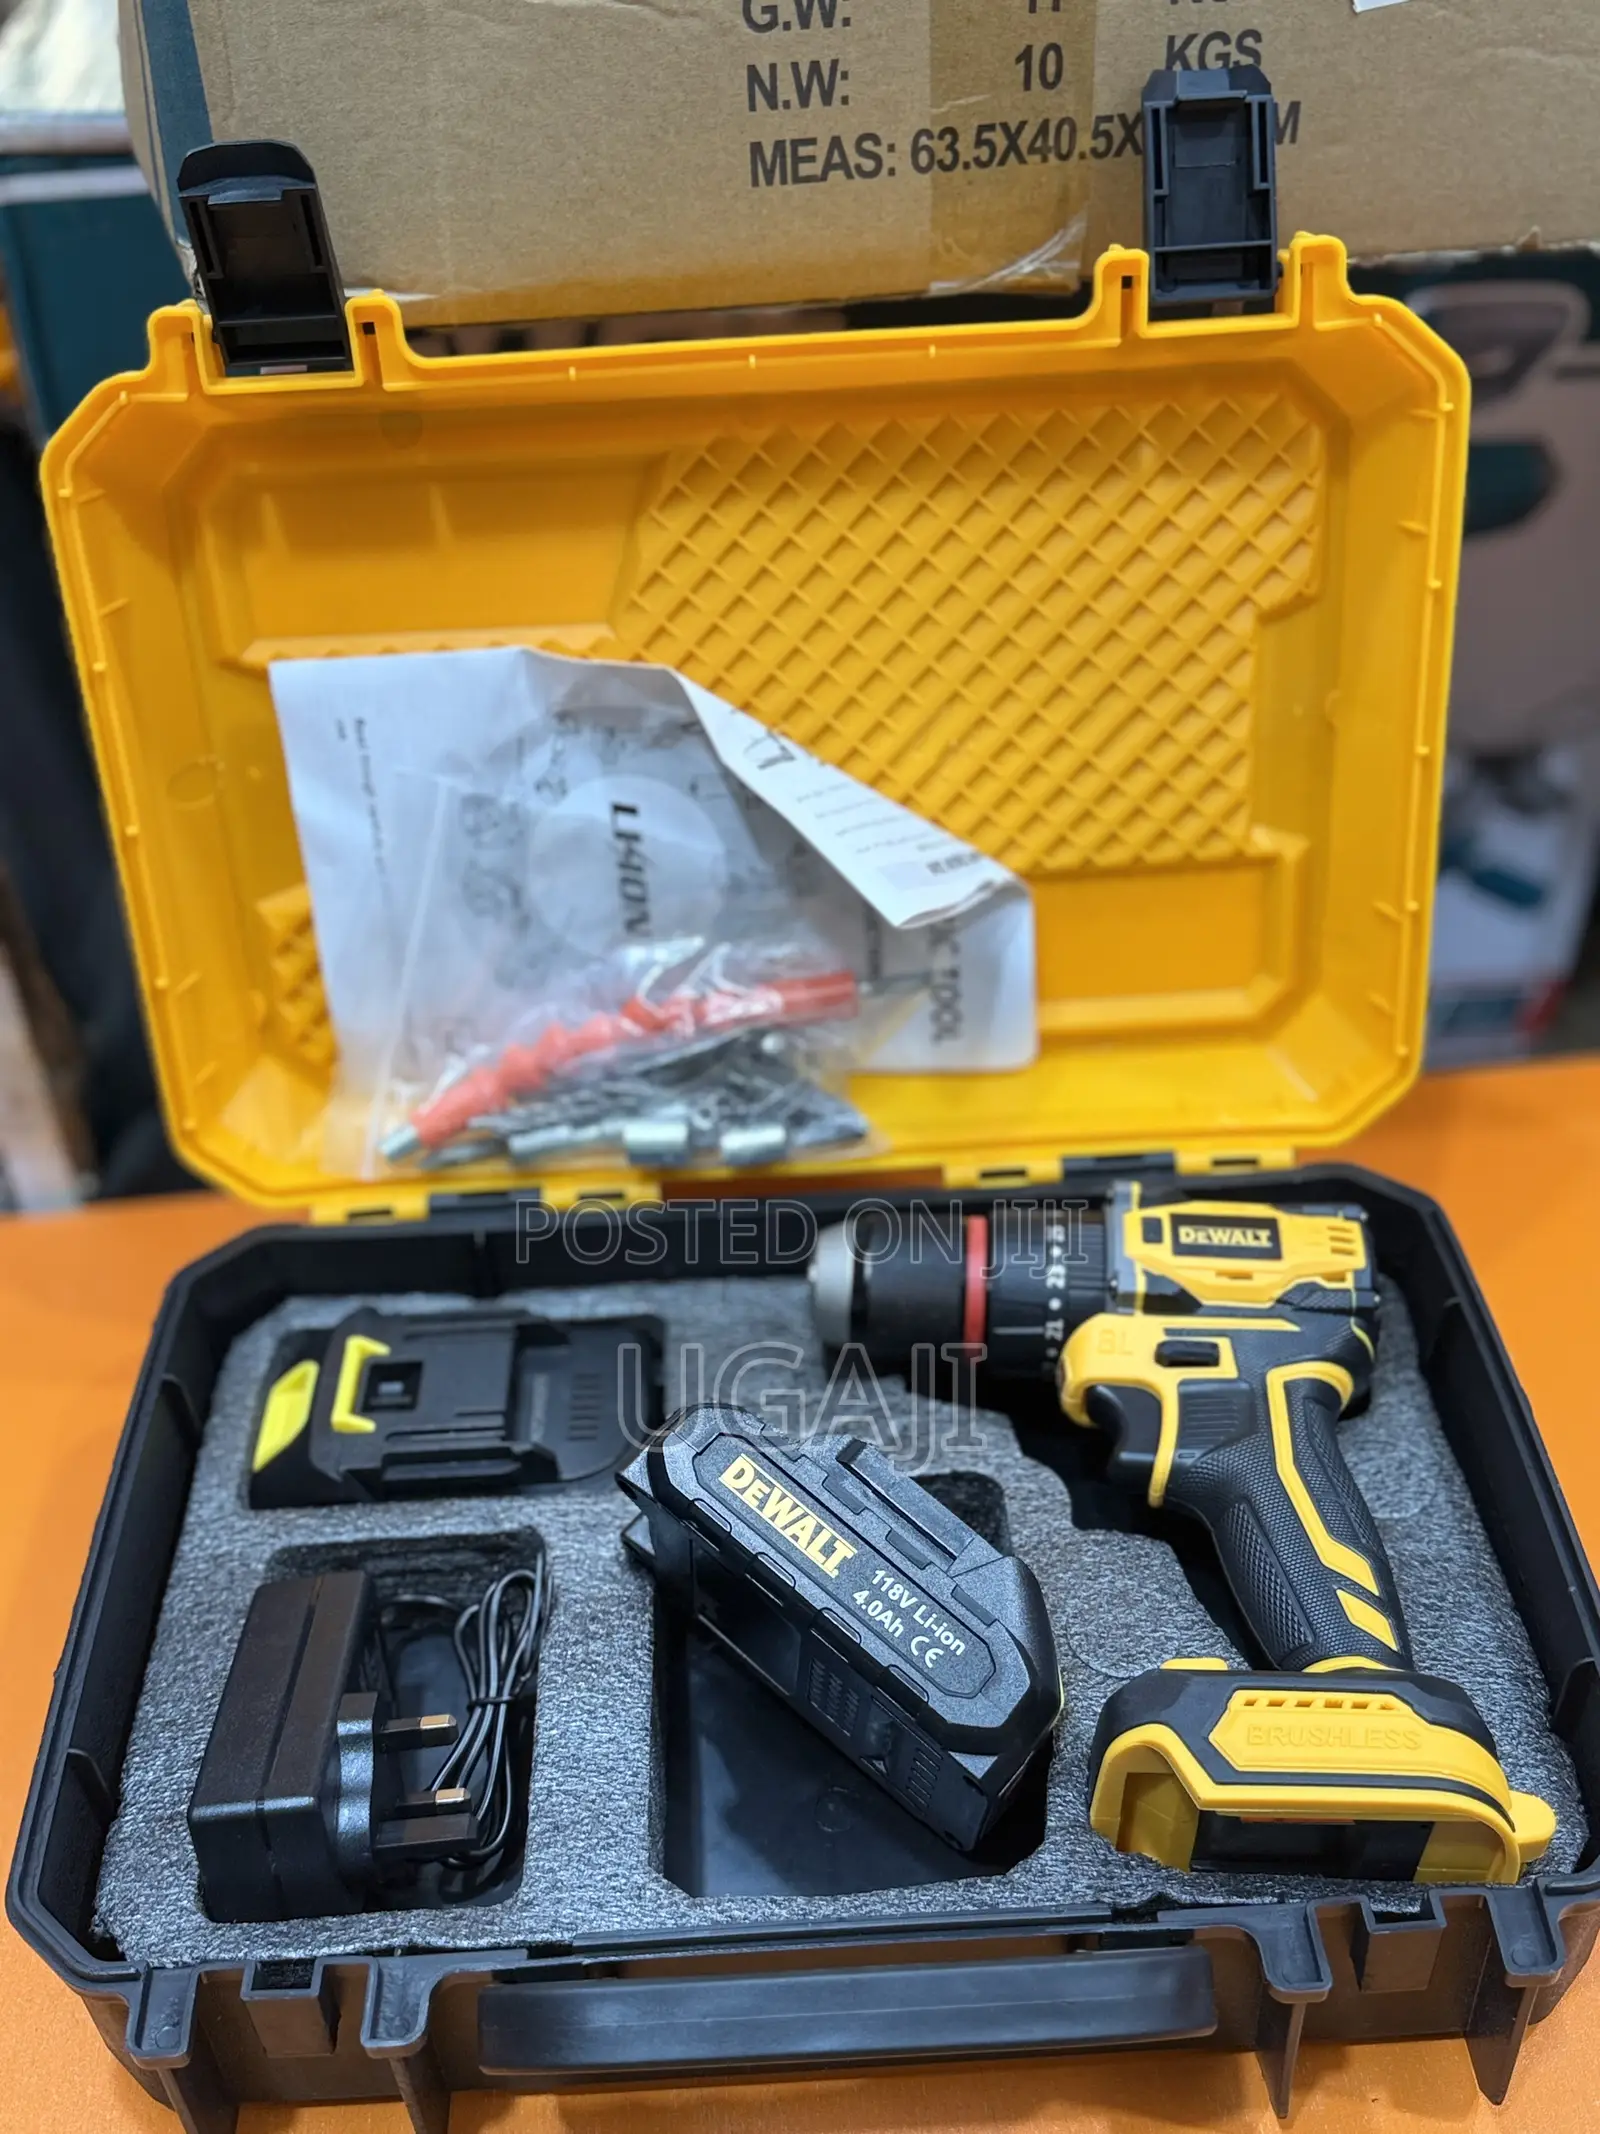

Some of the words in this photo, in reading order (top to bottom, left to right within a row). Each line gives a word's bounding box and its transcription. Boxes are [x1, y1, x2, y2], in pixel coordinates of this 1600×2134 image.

[746, 58, 849, 113] N.W:
[1014, 42, 1064, 92] 10
[1165, 28, 1263, 71] KGS
[749, 132, 896, 188] MEAS:
[1177, 1225, 1274, 1248] DEWALT
[718, 1453, 858, 1578] DEWALT
[852, 1590, 904, 1638] 4.0Ah
[872, 1569, 918, 1609] 118V
[912, 1604, 966, 1656] Li-ion
[1246, 1723, 1422, 1751] BRUSHLESS
